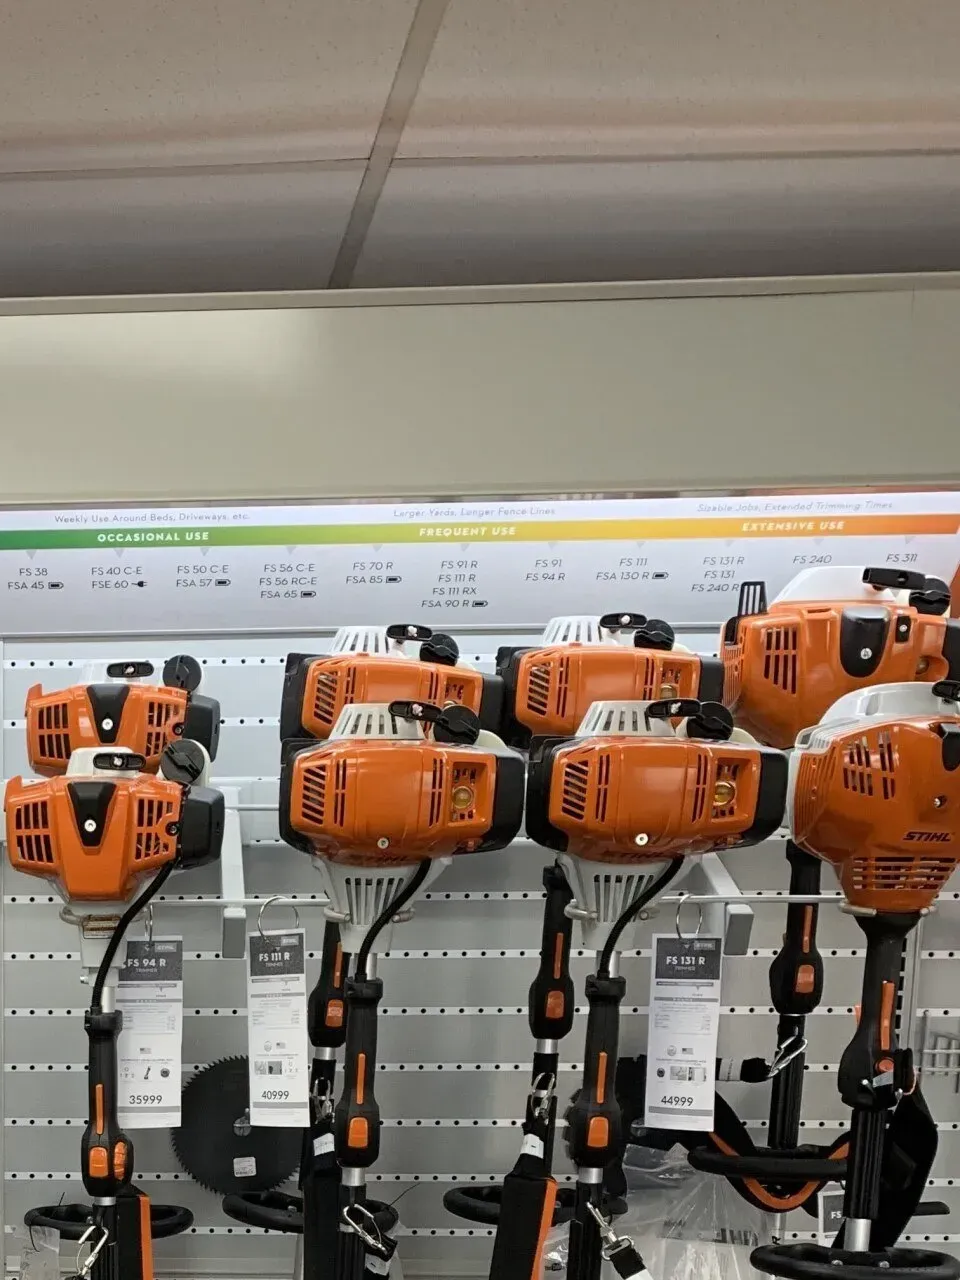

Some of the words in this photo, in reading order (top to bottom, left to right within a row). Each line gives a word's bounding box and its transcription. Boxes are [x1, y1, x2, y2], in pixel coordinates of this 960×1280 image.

[530, 506, 556, 515] Lines
[764, 502, 812, 511] Extended
[865, 500, 893, 509] Times
[54, 516, 88, 524] Weekly
[112, 514, 146, 522] Around
[742, 521, 815, 532] EXTENSIVE
[819, 520, 846, 531] USE
[419, 526, 488, 537] FREQUENT
[492, 526, 516, 536] USE
[98, 532, 181, 542] OCCASIONAL
[186, 532, 209, 541] USE
[535, 559, 548, 568] FS
[551, 558, 562, 568] 91
[619, 558, 633, 567] FS
[636, 557, 648, 566] 111
[703, 556, 716, 566] FS
[720, 556, 734, 565] 131
[736, 556, 745, 565] R
[793, 555, 806, 564] FS
[809, 554, 832, 564] 240
[886, 554, 900, 563] FS
[904, 553, 918, 562] 311
[177, 565, 190, 574] FS
[192, 565, 207, 574] 50
[210, 564, 229, 574] C-E
[264, 564, 277, 573] FS
[279, 563, 293, 573] 56
[296, 563, 315, 572] C-E
[353, 562, 366, 571] FS
[368, 562, 383, 571] 70
[386, 561, 394, 571] R
[441, 560, 454, 569] FS
[456, 560, 468, 569] 91
[470, 560, 478, 569] R
[19, 568, 32, 577] FS
[35, 567, 48, 577] 38
[91, 566, 104, 576] FS
[106, 566, 121, 576] 40
[124, 566, 143, 575] C-E
[596, 572, 617, 580] FSA
[620, 571, 640, 580] 130
[642, 571, 650, 580] R
[704, 570, 717, 579] FS
[721, 570, 735, 579] 131
[260, 577, 272, 586] FS
[274, 577, 289, 586] 56
[291, 576, 318, 585] RC-E
[346, 576, 366, 584] FSA
[370, 575, 383, 584] 85
[438, 574, 452, 583] FS
[454, 574, 466, 583] 111
[468, 573, 476, 582] R
[526, 572, 539, 581] FS
[542, 572, 556, 581] 94
[558, 572, 566, 581] R
[8, 582, 28, 590] FSA
[30, 581, 45, 590] 45
[92, 580, 112, 589] FSE
[114, 580, 129, 589] 60
[176, 579, 196, 588] FSA
[199, 578, 212, 588] 57
[691, 584, 705, 593] FS
[707, 583, 729, 592] 240
[732, 583, 740, 592] R
[260, 590, 281, 599] FSA
[284, 590, 298, 599] 65
[432, 587, 446, 596] FS
[448, 587, 460, 596] 111
[462, 586, 477, 595] RX
[421, 600, 442, 608] FSA
[444, 600, 460, 608] 90
[462, 599, 470, 608] R
[903, 831, 952, 842] STIHL
[259, 954, 269, 962] FS
[271, 952, 282, 961] 111
[284, 952, 290, 961] R
[666, 956, 678, 965] FS
[680, 956, 695, 965] 131
[698, 957, 706, 965] R
[127, 959, 140, 967] FS
[142, 959, 156, 967] 94
[160, 958, 167, 967] R
[831, 1211, 842, 1219] FS
